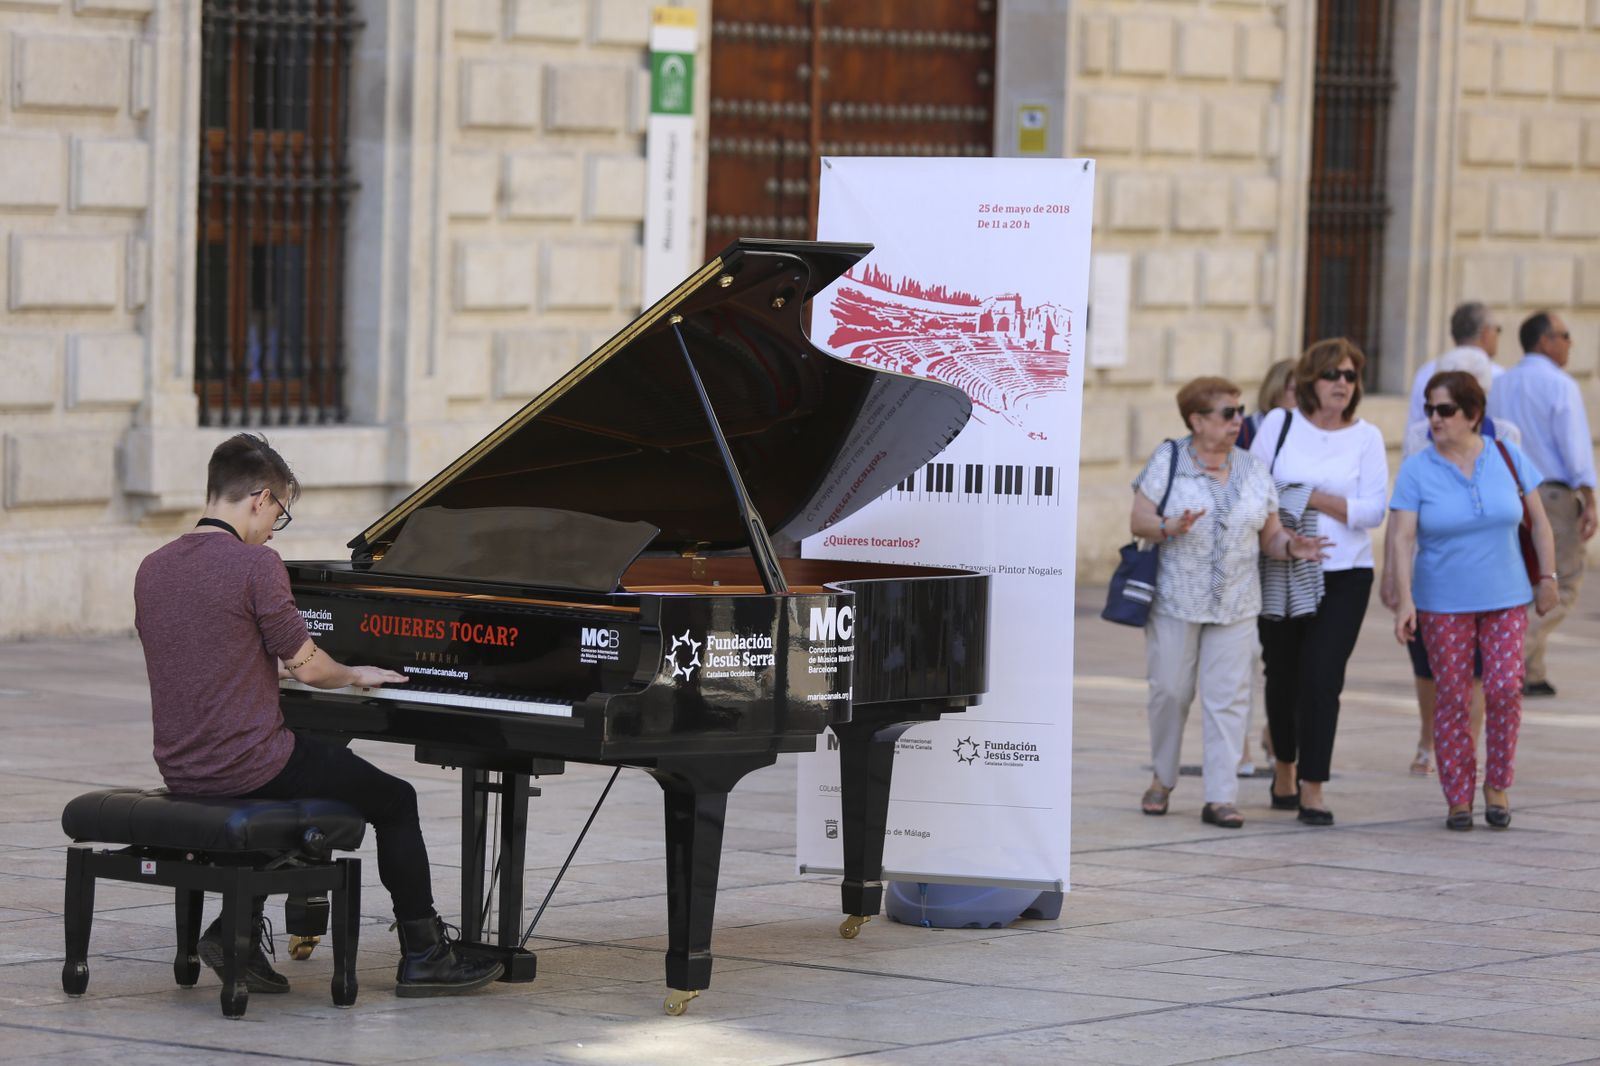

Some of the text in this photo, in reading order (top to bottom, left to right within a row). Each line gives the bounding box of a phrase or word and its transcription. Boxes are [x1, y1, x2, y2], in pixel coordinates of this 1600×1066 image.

[979, 204, 1070, 215] 25 de mayo de 2018
[978, 219, 1030, 229] De 11 a 20 h
[824, 535, 920, 549] ¿Quieres tocarlos?
[999, 564, 1025, 575] Pintor
[1028, 566, 1063, 577] Nogales
[297, 608, 332, 620] undación
[313, 620, 334, 631] Serra
[810, 605, 857, 641] MC
[360, 613, 519, 647] ¿QUIERES TOCAR?
[581, 627, 620, 649] MCB
[706, 633, 773, 651] Fundación
[808, 646, 837, 654] Concurso
[415, 651, 459, 665] YAMAHA
[706, 651, 776, 668] Jesús Serra
[808, 656, 816, 664] de
[817, 655, 837, 663] Música
[403, 664, 469, 680] www.mariacanals.org
[808, 665, 837, 673] Barcelona
[984, 740, 1037, 752] Fundación
[983, 750, 1040, 762] Jesús Serra
[904, 829, 931, 839] Málaga
